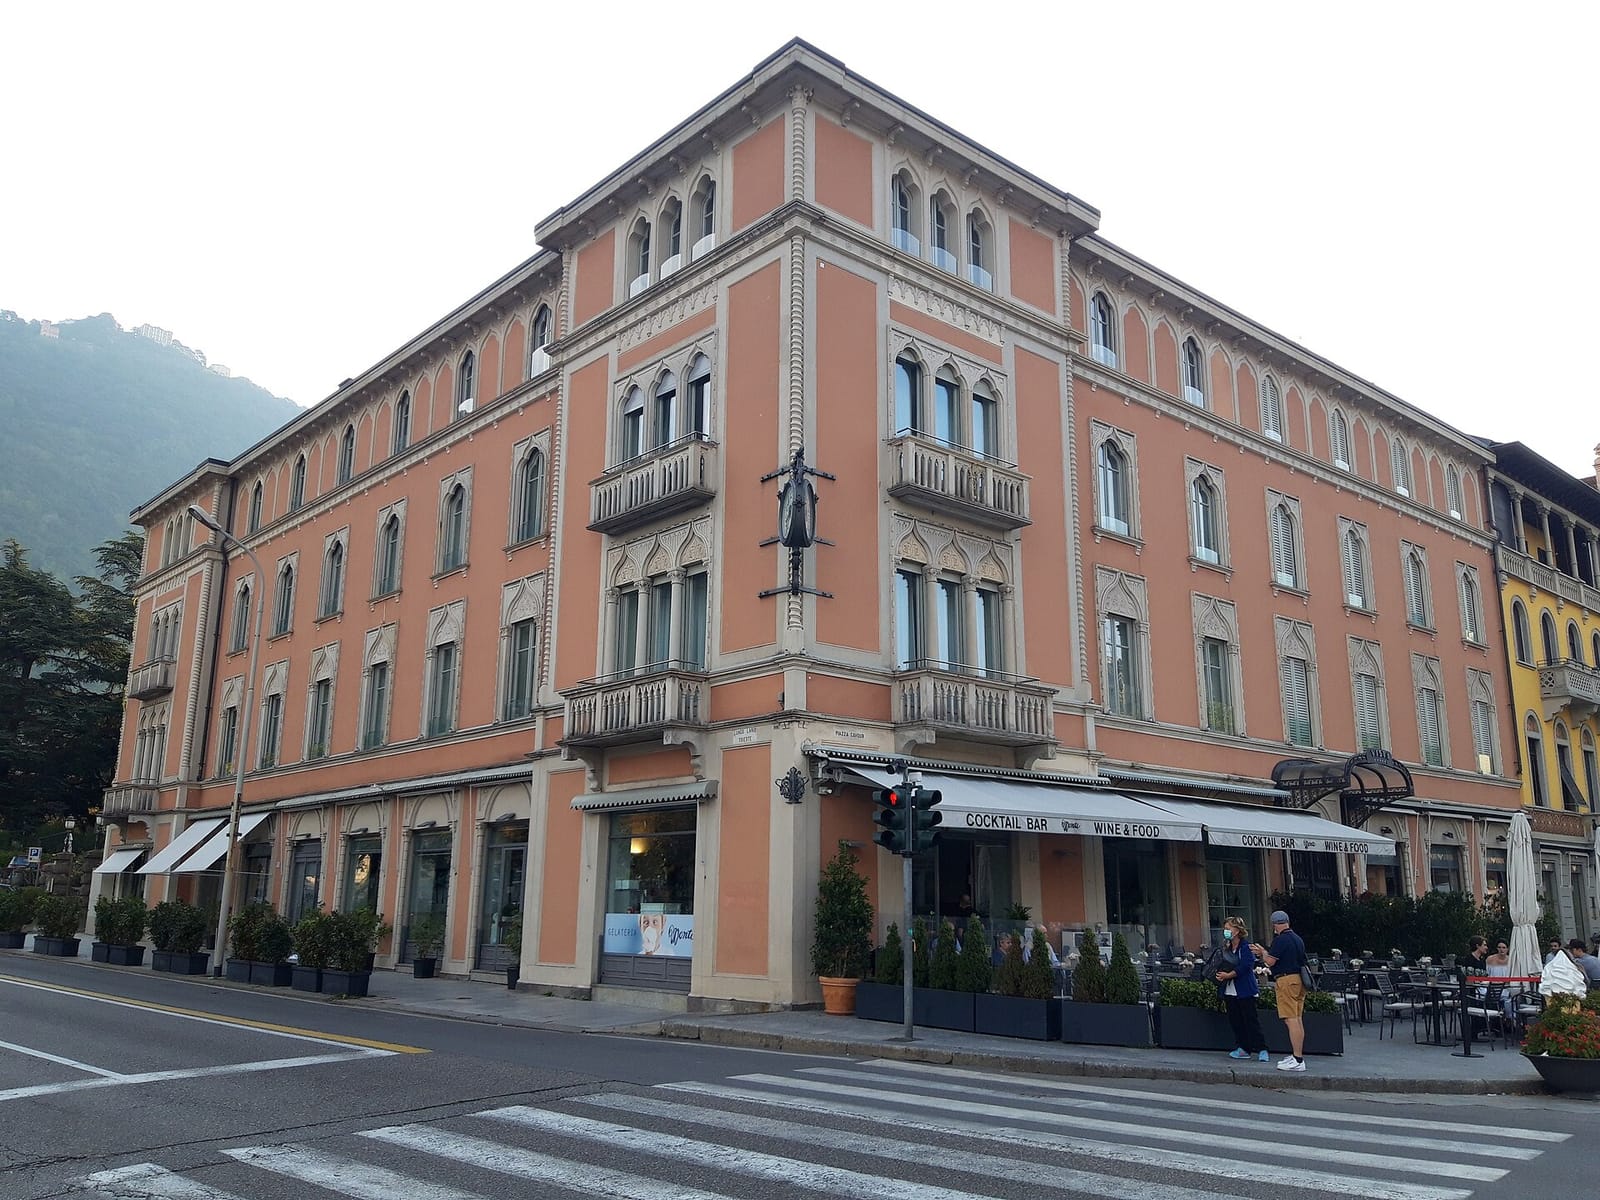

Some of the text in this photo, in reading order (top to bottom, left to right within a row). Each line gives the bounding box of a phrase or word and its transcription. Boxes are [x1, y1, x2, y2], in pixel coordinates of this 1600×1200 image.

[966, 813, 1021, 829] COCKTAIL
[1026, 817, 1048, 831] BAR
[1093, 822, 1120, 835] WINE
[1123, 823, 1130, 836] &
[1132, 824, 1160, 837] FOOD
[1241, 834, 1279, 848] COCKTAIL
[1280, 837, 1296, 849] BAR
[1324, 840, 1343, 852] WINE
[1344, 842, 1349, 852] &
[1350, 842, 1369, 854] FOOD
[608, 927, 637, 937] GELATERIA
